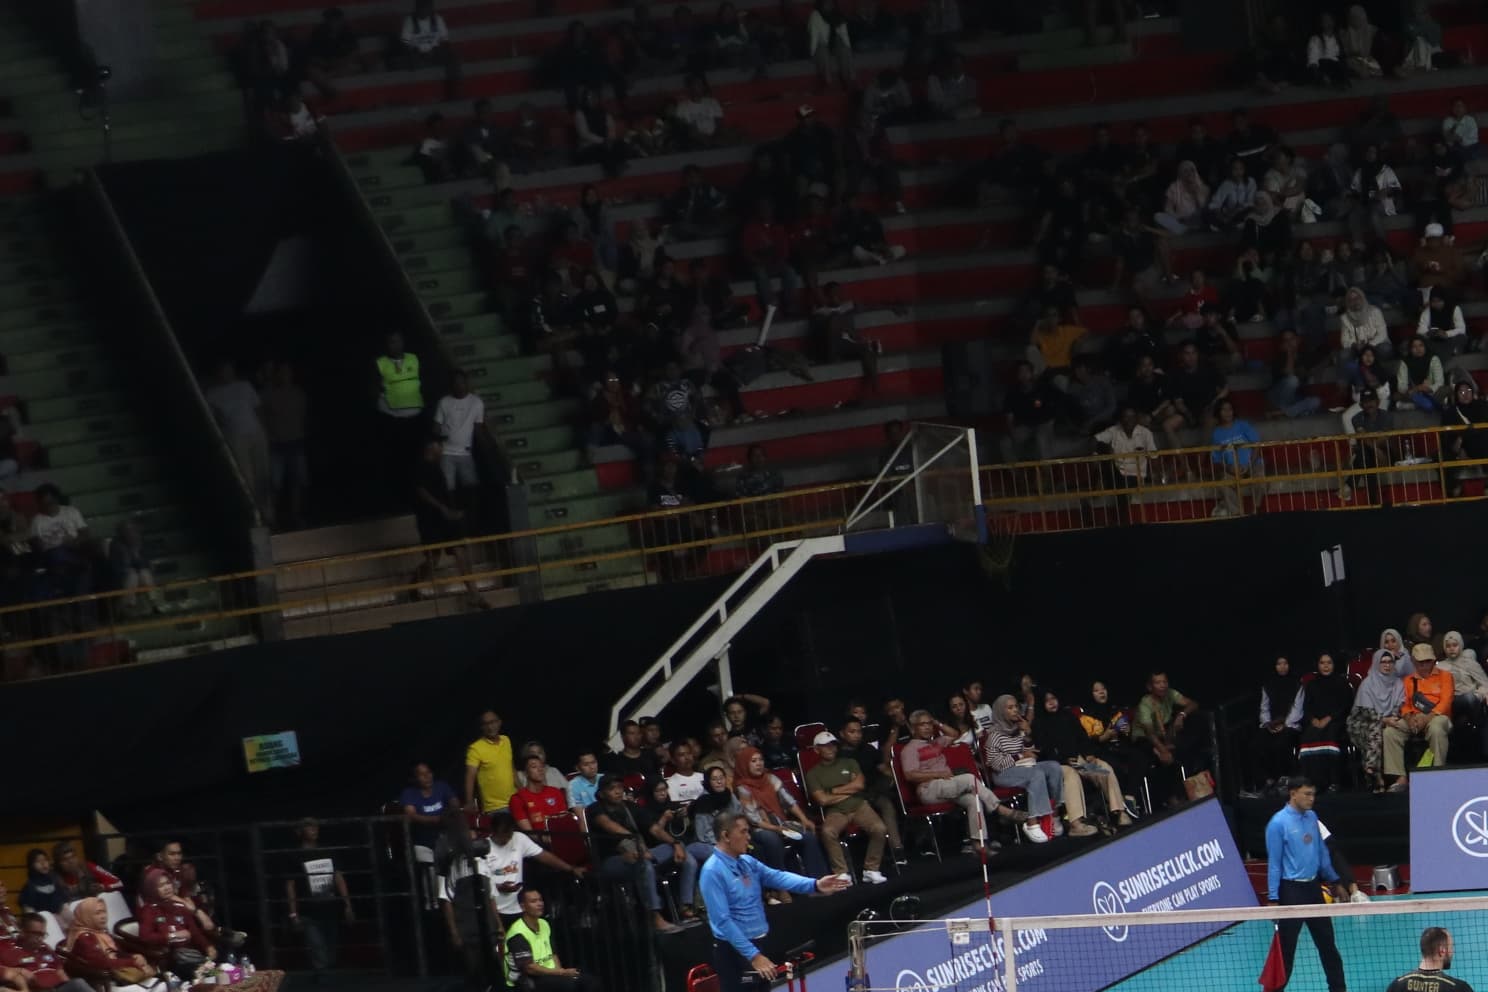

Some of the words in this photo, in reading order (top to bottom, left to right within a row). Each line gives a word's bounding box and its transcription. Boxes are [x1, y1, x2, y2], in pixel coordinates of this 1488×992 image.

[1118, 838, 1224, 903] SUNRISECLICK.COM
[1198, 874, 1221, 896] SPORTS
[1018, 958, 1044, 982] SPORTS
[1407, 979, 1440, 992] GUNTER
